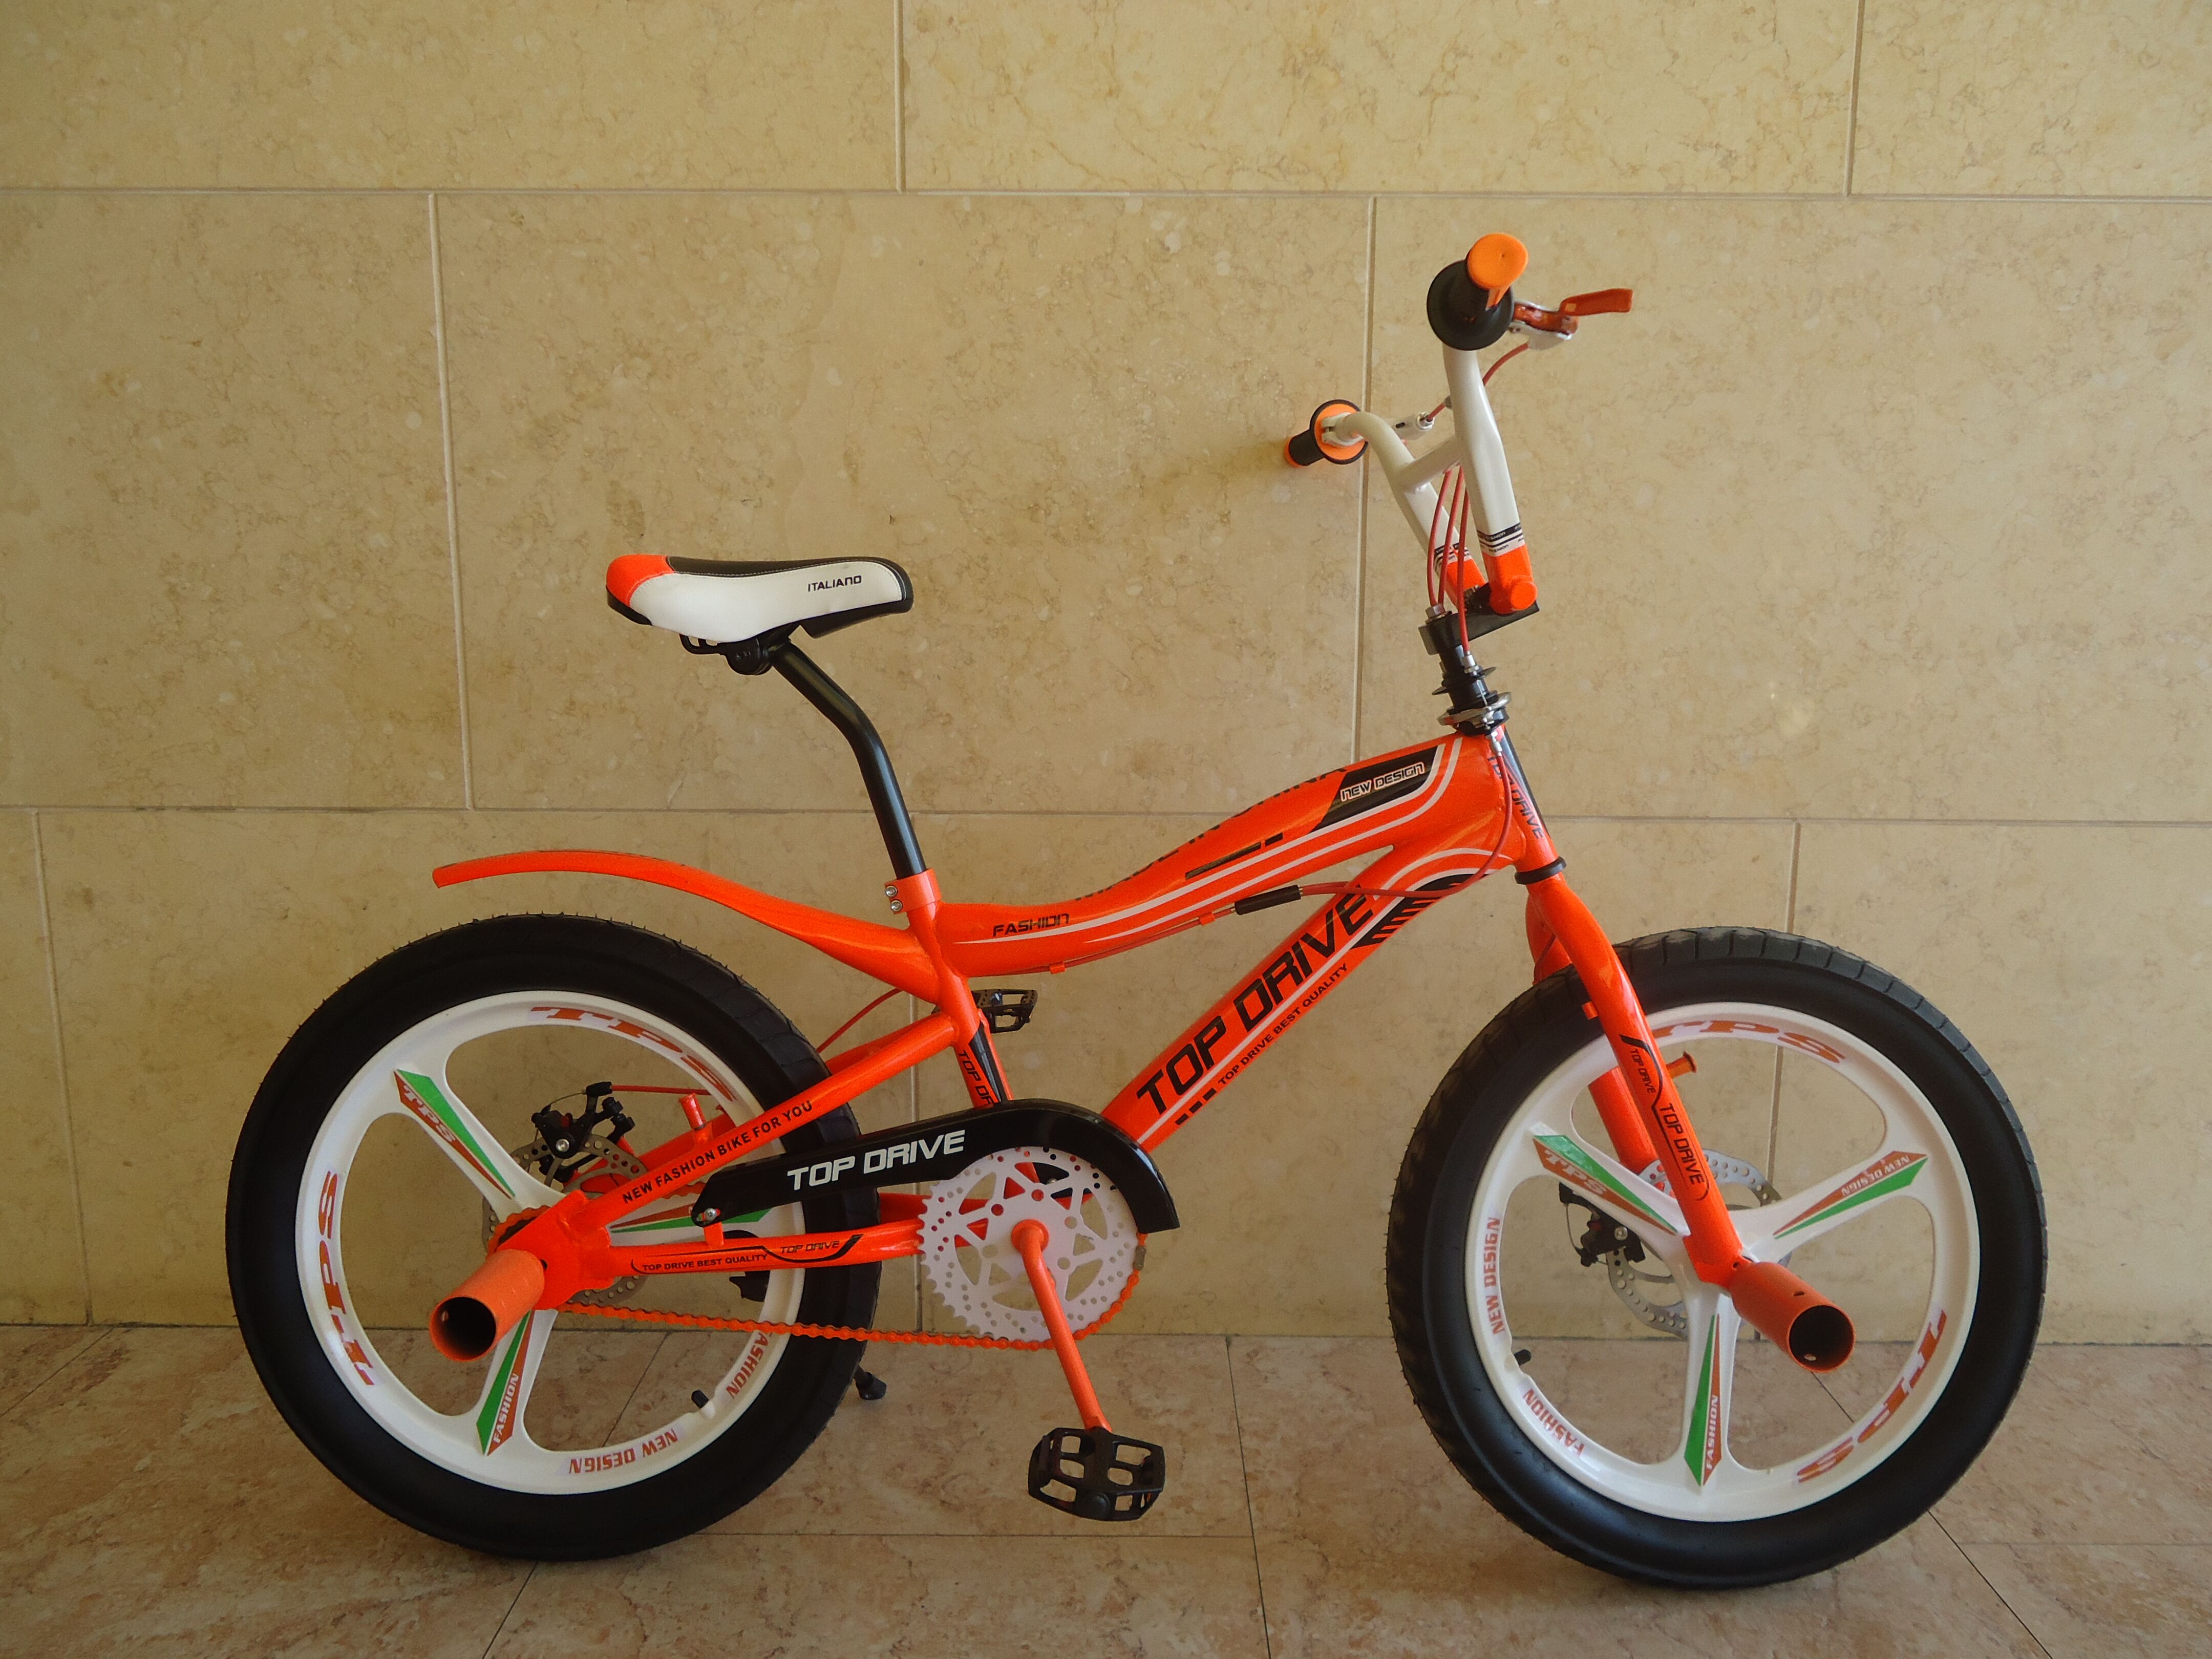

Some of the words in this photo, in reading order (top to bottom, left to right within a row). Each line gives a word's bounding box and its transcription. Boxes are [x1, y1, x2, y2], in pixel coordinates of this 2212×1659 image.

[808, 575, 862, 592] ITALIANO
[1340, 780, 1372, 802] NEW
[1373, 762, 1426, 790] DESIGN
[1512, 789, 1545, 839] DRIVE
[993, 912, 1070, 937] FASHION
[1137, 1015, 1227, 1115] TOP
[1233, 883, 1374, 1033] DRIVE
[1218, 1065, 1240, 1085] TOP
[1240, 1034, 1274, 1066] DRIVE
[1272, 1007, 1301, 1034] BEST
[1302, 963, 1348, 1008] QUALITY
[531, 1006, 737, 1102] TPS
[959, 1050, 982, 1081] TOP
[1630, 1049, 1645, 1068] TOP
[1639, 1068, 1656, 1093] DRIVE
[403, 1085, 456, 1142] TPS
[622, 1181, 653, 1204] NEW
[655, 1150, 715, 1188] FASHION
[717, 1131, 752, 1156] BIKE
[752, 1117, 782, 1138] FOR
[782, 1100, 813, 1122] YOU
[787, 1156, 856, 1190] TOP
[863, 1130, 966, 1174] DRIVE
[1660, 1103, 1684, 1134] TOP
[1674, 1138, 1705, 1185] DRIVE
[1884, 1155, 1910, 1174] NEW
[1544, 1150, 1607, 1195] TPS
[664, 1261, 695, 1270] DRIVE
[696, 1258, 722, 1267] BEST
[725, 1253, 769, 1265] QUALITY
[779, 1245, 803, 1254] TOP
[805, 1241, 840, 1252] DRIVE
[1483, 1217, 1501, 1288] DESIGN
[1485, 1295, 1505, 1334] NEW
[726, 1332, 769, 1399] ASHION
[493, 1373, 519, 1443] FASHION
[1522, 1389, 1585, 1457] FASHION
[1706, 1394, 1718, 1469] FASHION
[569, 1448, 636, 1474] DESIGN
[642, 1428, 678, 1458] NEW
